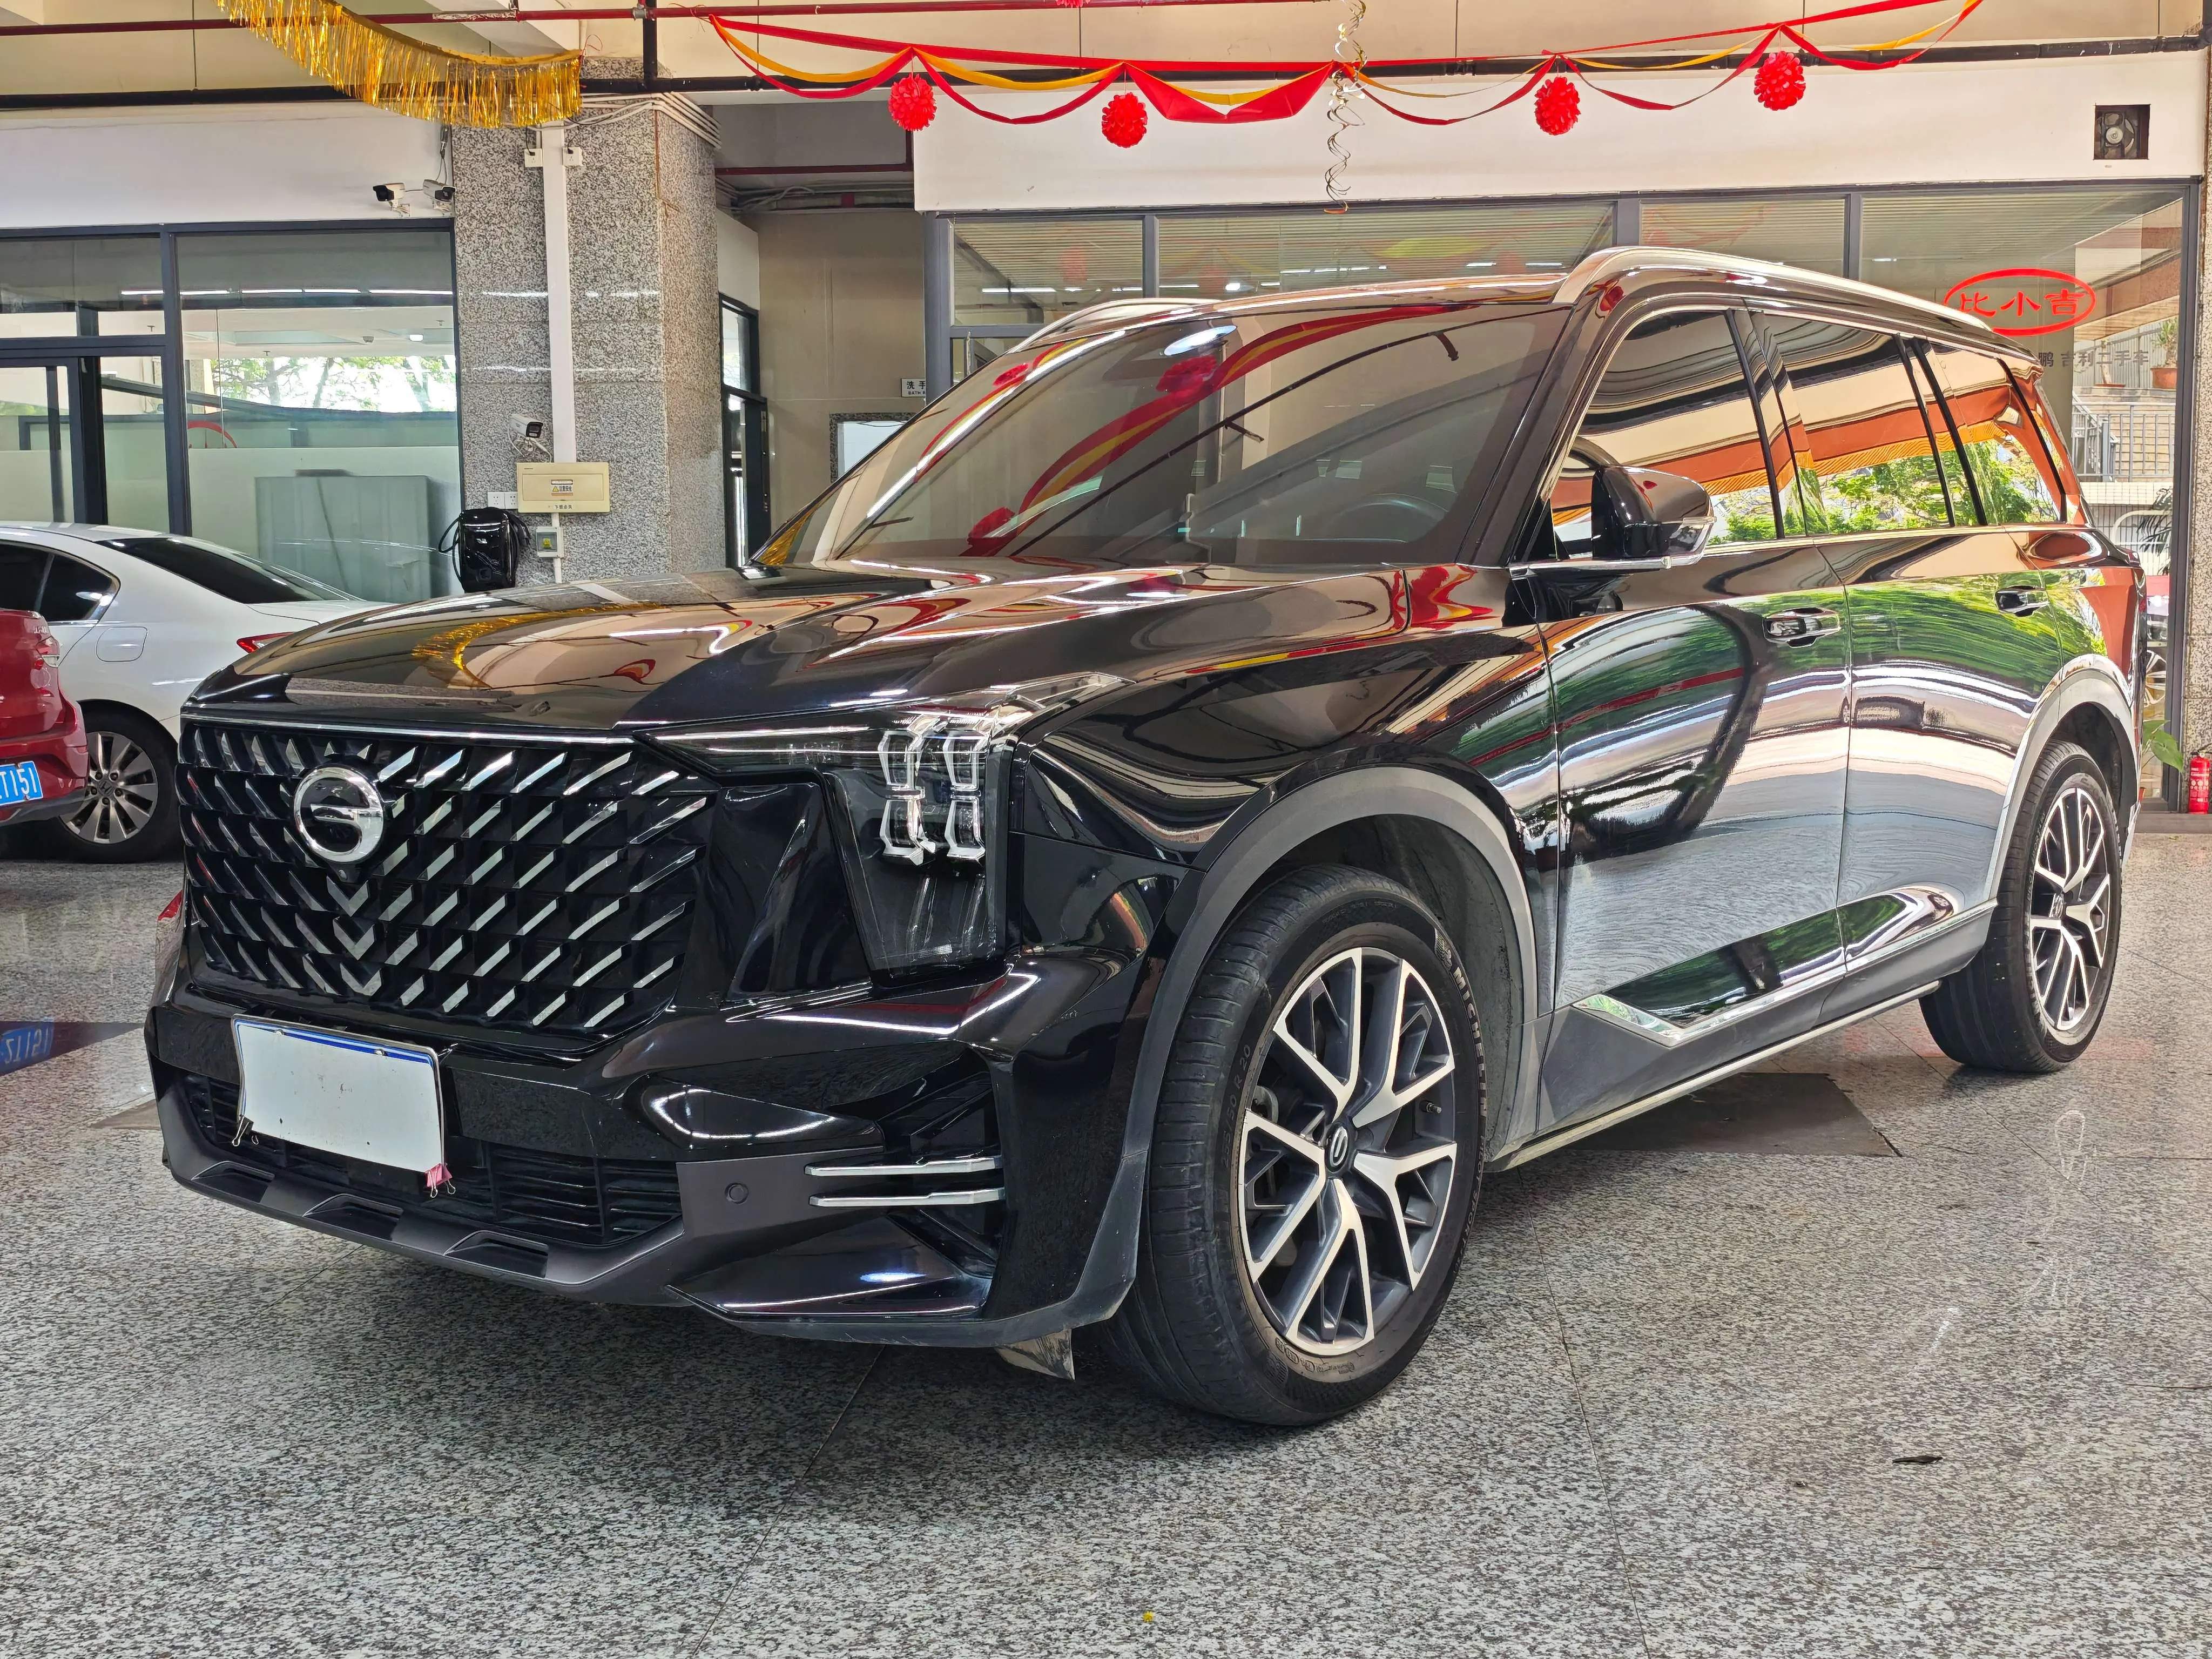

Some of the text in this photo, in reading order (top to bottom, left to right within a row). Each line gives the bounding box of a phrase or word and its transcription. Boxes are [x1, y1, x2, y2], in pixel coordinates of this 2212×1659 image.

[1960, 288, 2086, 318] 比小吉
[0, 767, 37, 799] T151
[1453, 966, 1487, 1117] MICHELIN
[1239, 1044, 1251, 1071] 20
